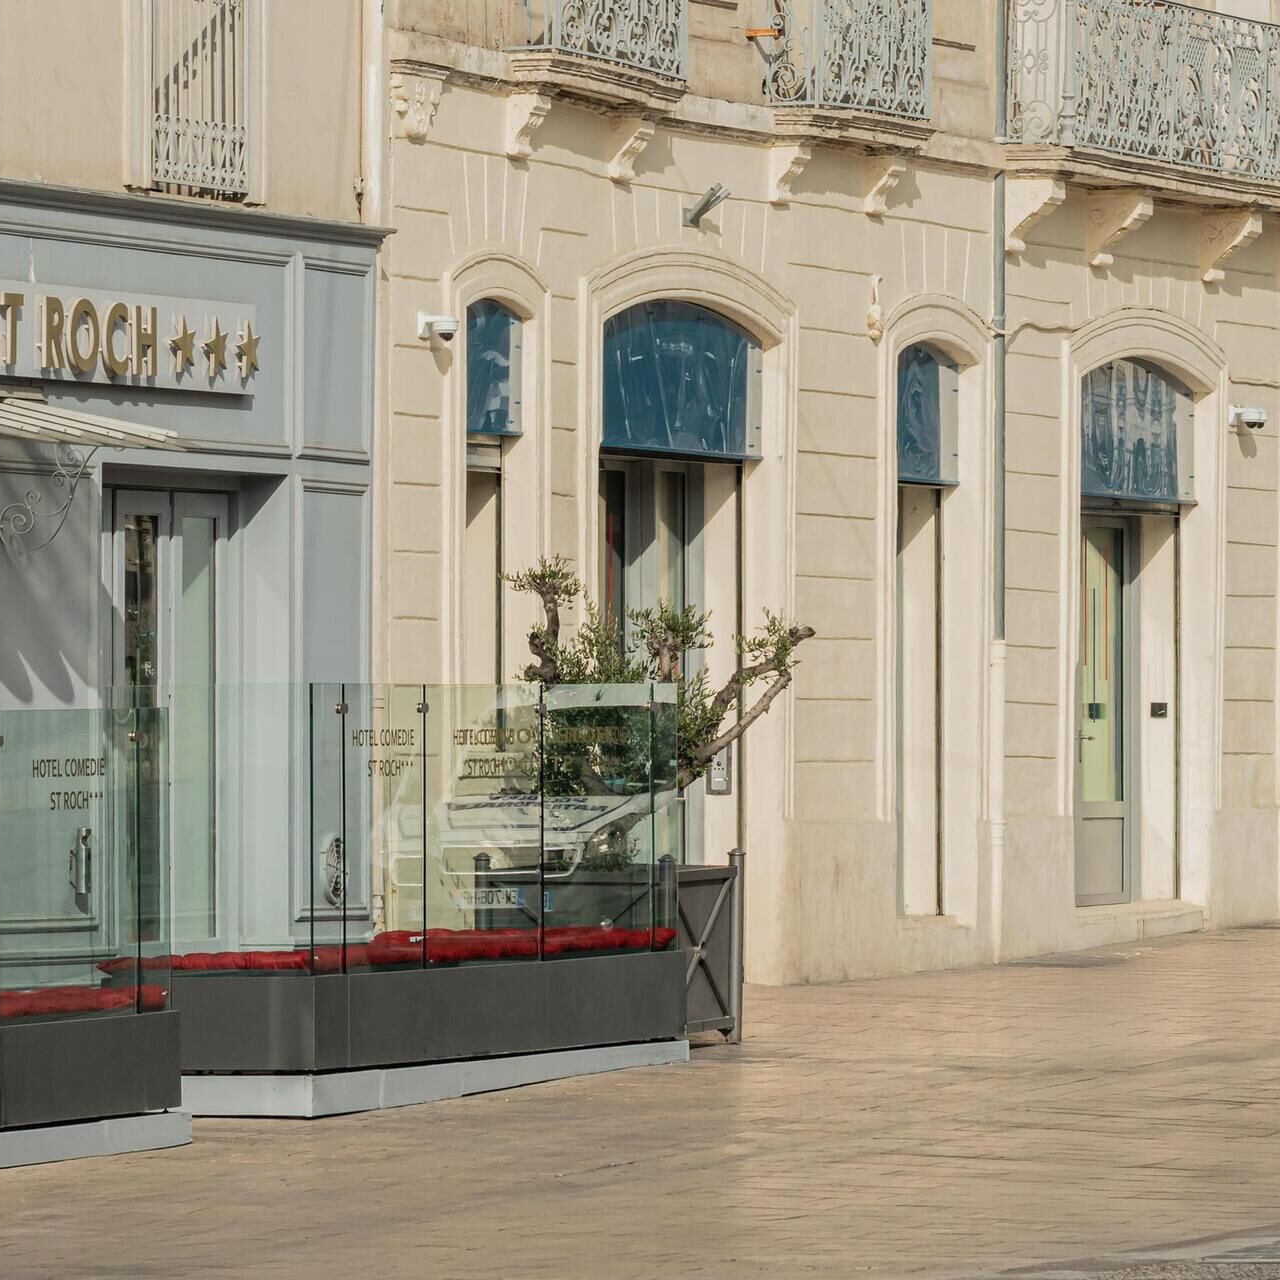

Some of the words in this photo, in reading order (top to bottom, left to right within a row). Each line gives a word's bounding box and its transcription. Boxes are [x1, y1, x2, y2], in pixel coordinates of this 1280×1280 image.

[41, 296, 158, 378] ROCH
[352, 729, 378, 746] HOTEL
[380, 729, 414, 746] COMEDIE
[32, 759, 62, 778] HOTEL
[65, 758, 105, 777] COMEDIE
[368, 760, 377, 777] ST
[379, 760, 401, 777] ROCH
[50, 792, 61, 810] ST
[64, 791, 89, 810] ROCH
